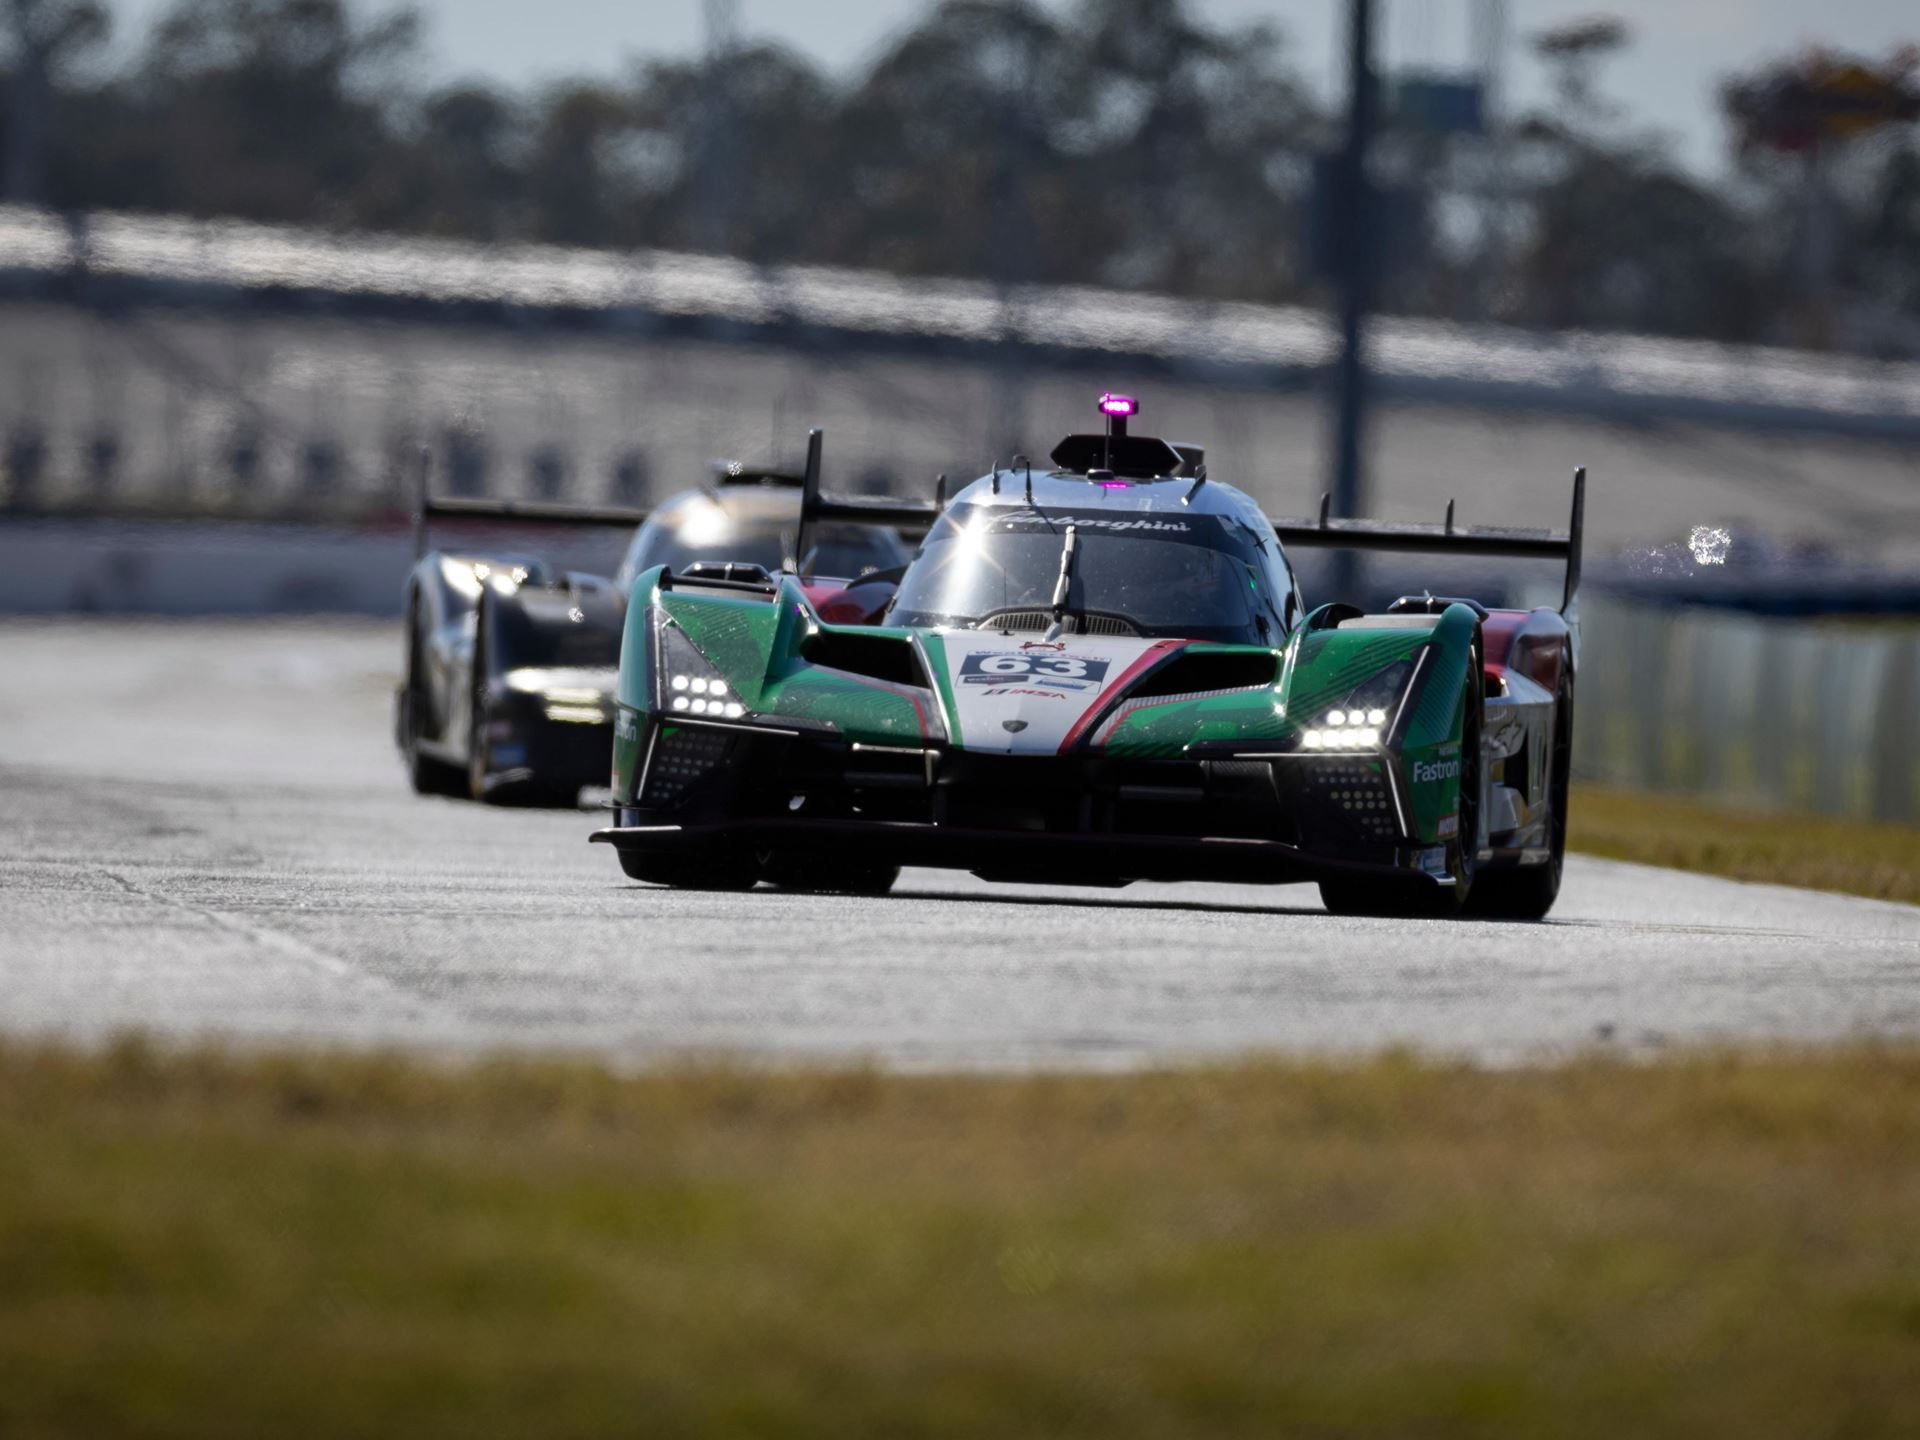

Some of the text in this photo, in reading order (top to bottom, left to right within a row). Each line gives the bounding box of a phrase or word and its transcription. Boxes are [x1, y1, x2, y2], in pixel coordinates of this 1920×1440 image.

[991, 510, 1191, 532] Lamborghini
[979, 655, 1088, 678] 63
[1413, 760, 1459, 783] Fastron
